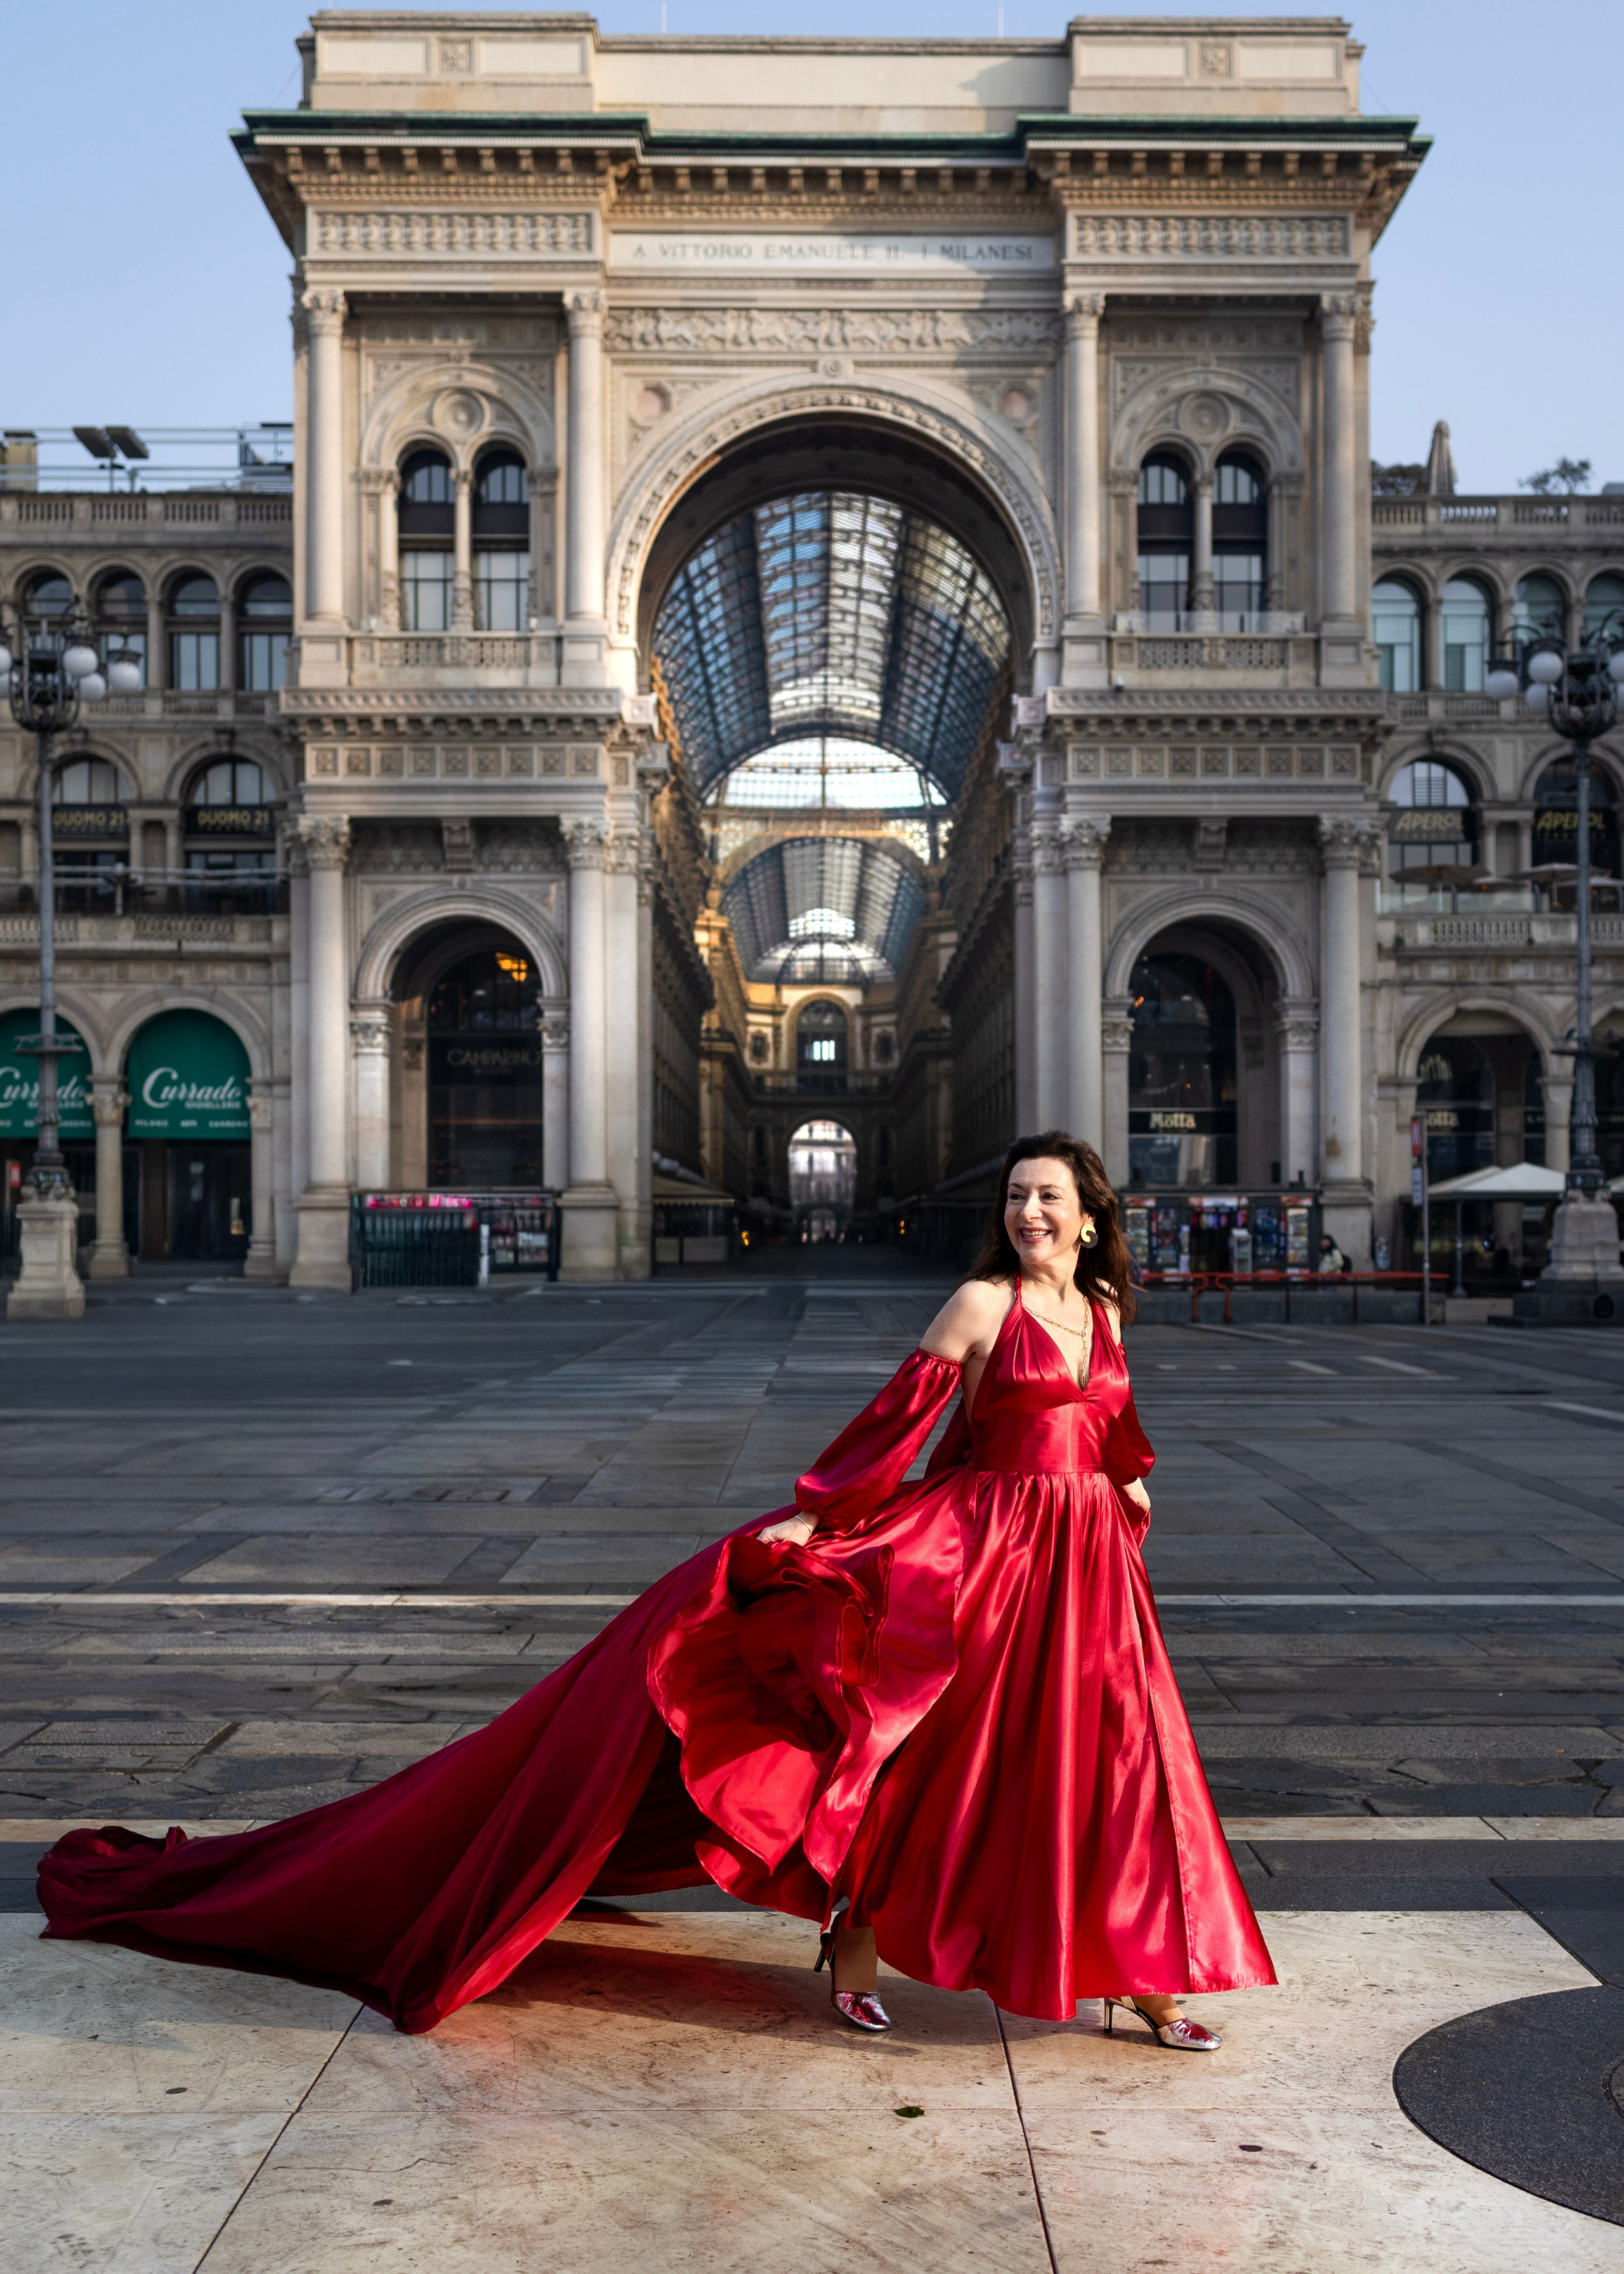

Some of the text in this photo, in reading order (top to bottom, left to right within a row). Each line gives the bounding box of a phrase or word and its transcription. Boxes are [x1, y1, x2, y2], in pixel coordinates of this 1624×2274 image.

[632, 244, 646, 258] A
[659, 243, 752, 259] VITTORIO
[763, 244, 874, 260] EMANUELE
[939, 244, 1032, 260] MILANESI
[53, 810, 125, 827] DUOMO 21
[197, 810, 270, 826] DUOMO 21
[1396, 812, 1464, 830] APEROL
[142, 1067, 242, 1109] Currado
[1149, 1112, 1196, 1129] Motta
[1427, 1111, 1460, 1127] otta
